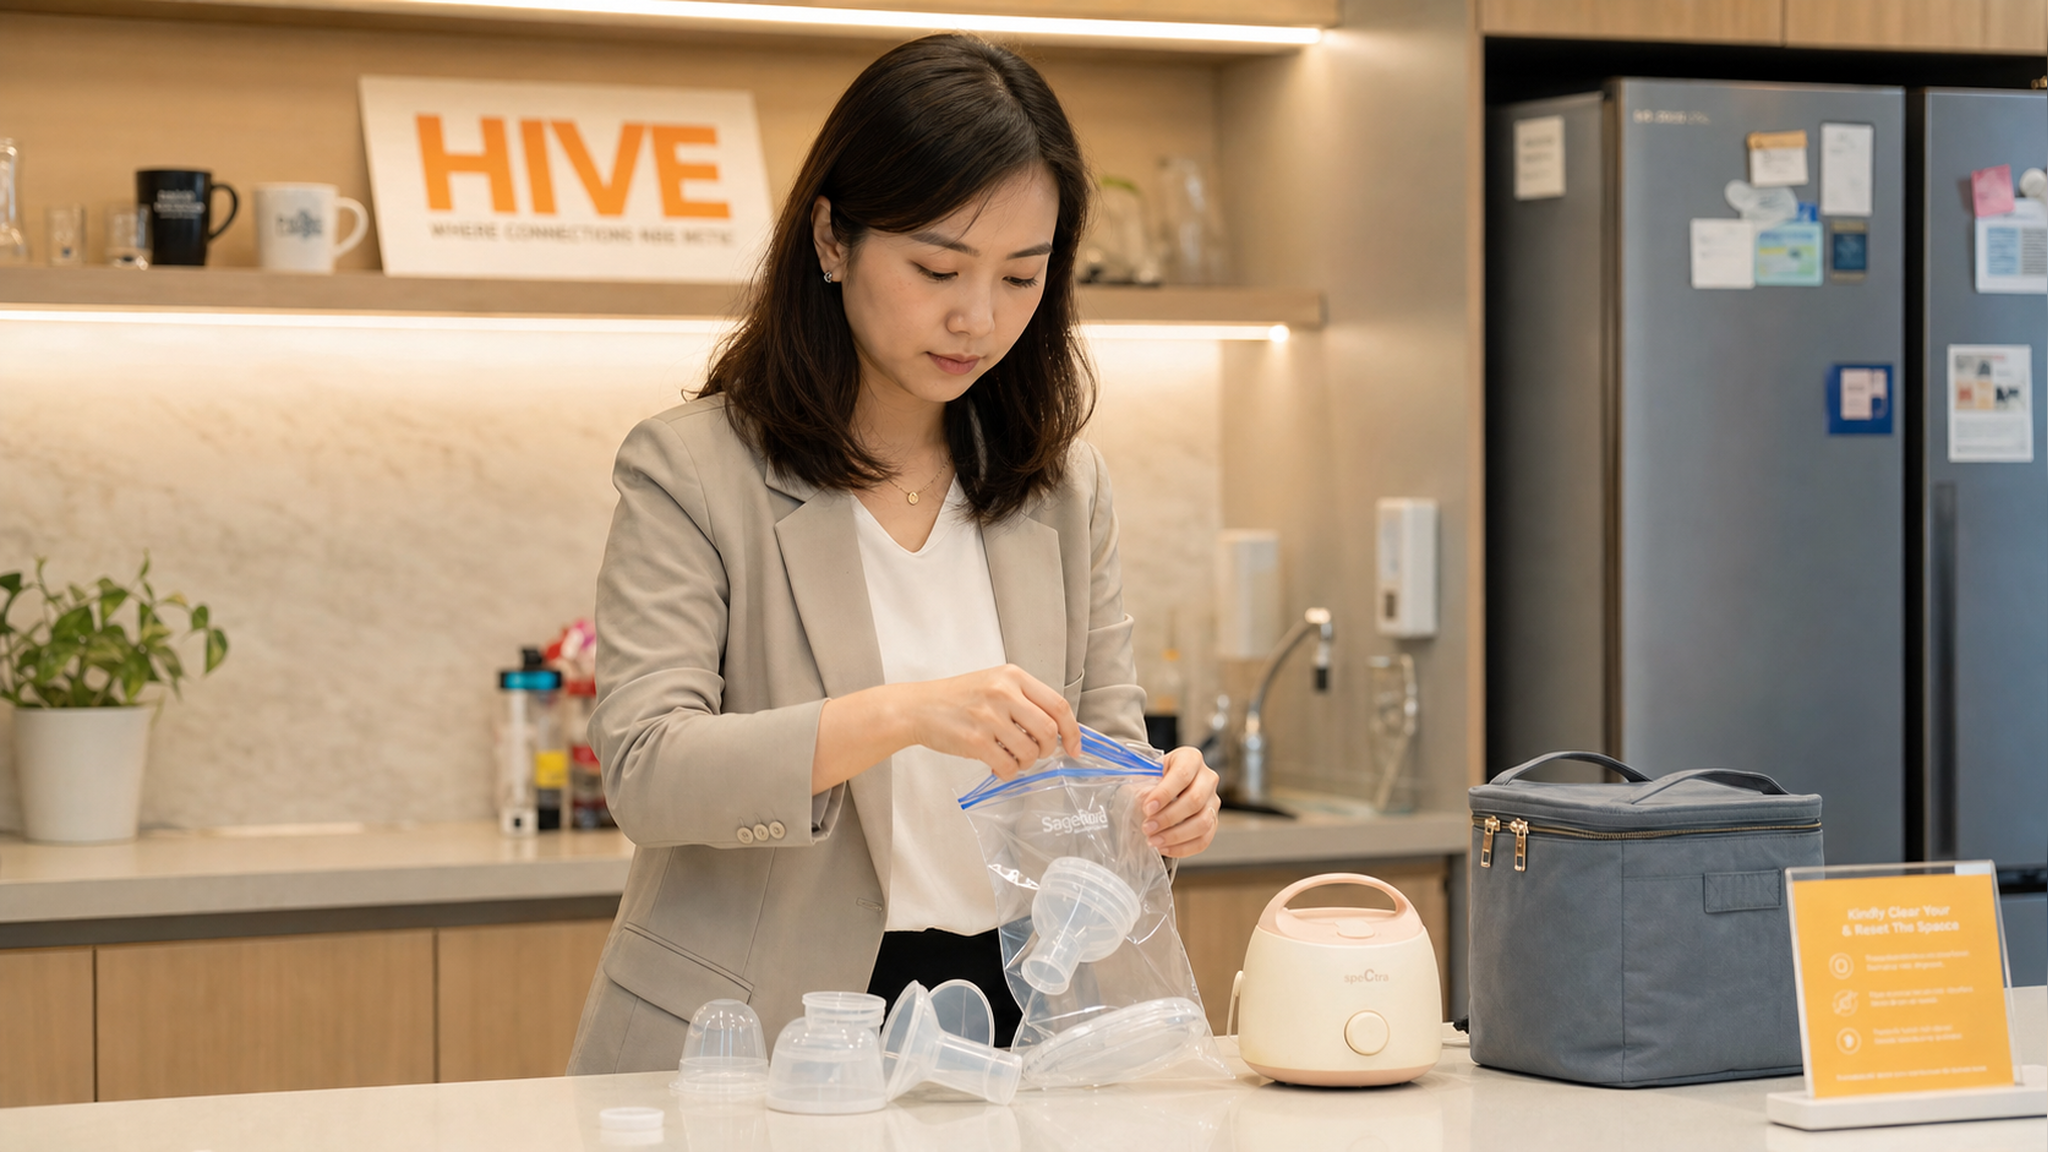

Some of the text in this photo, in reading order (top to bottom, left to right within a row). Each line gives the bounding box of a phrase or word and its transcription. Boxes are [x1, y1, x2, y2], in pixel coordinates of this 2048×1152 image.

[415, 113, 731, 219] HIVE
[1847, 904, 1951, 921] Kindly Clear Your
